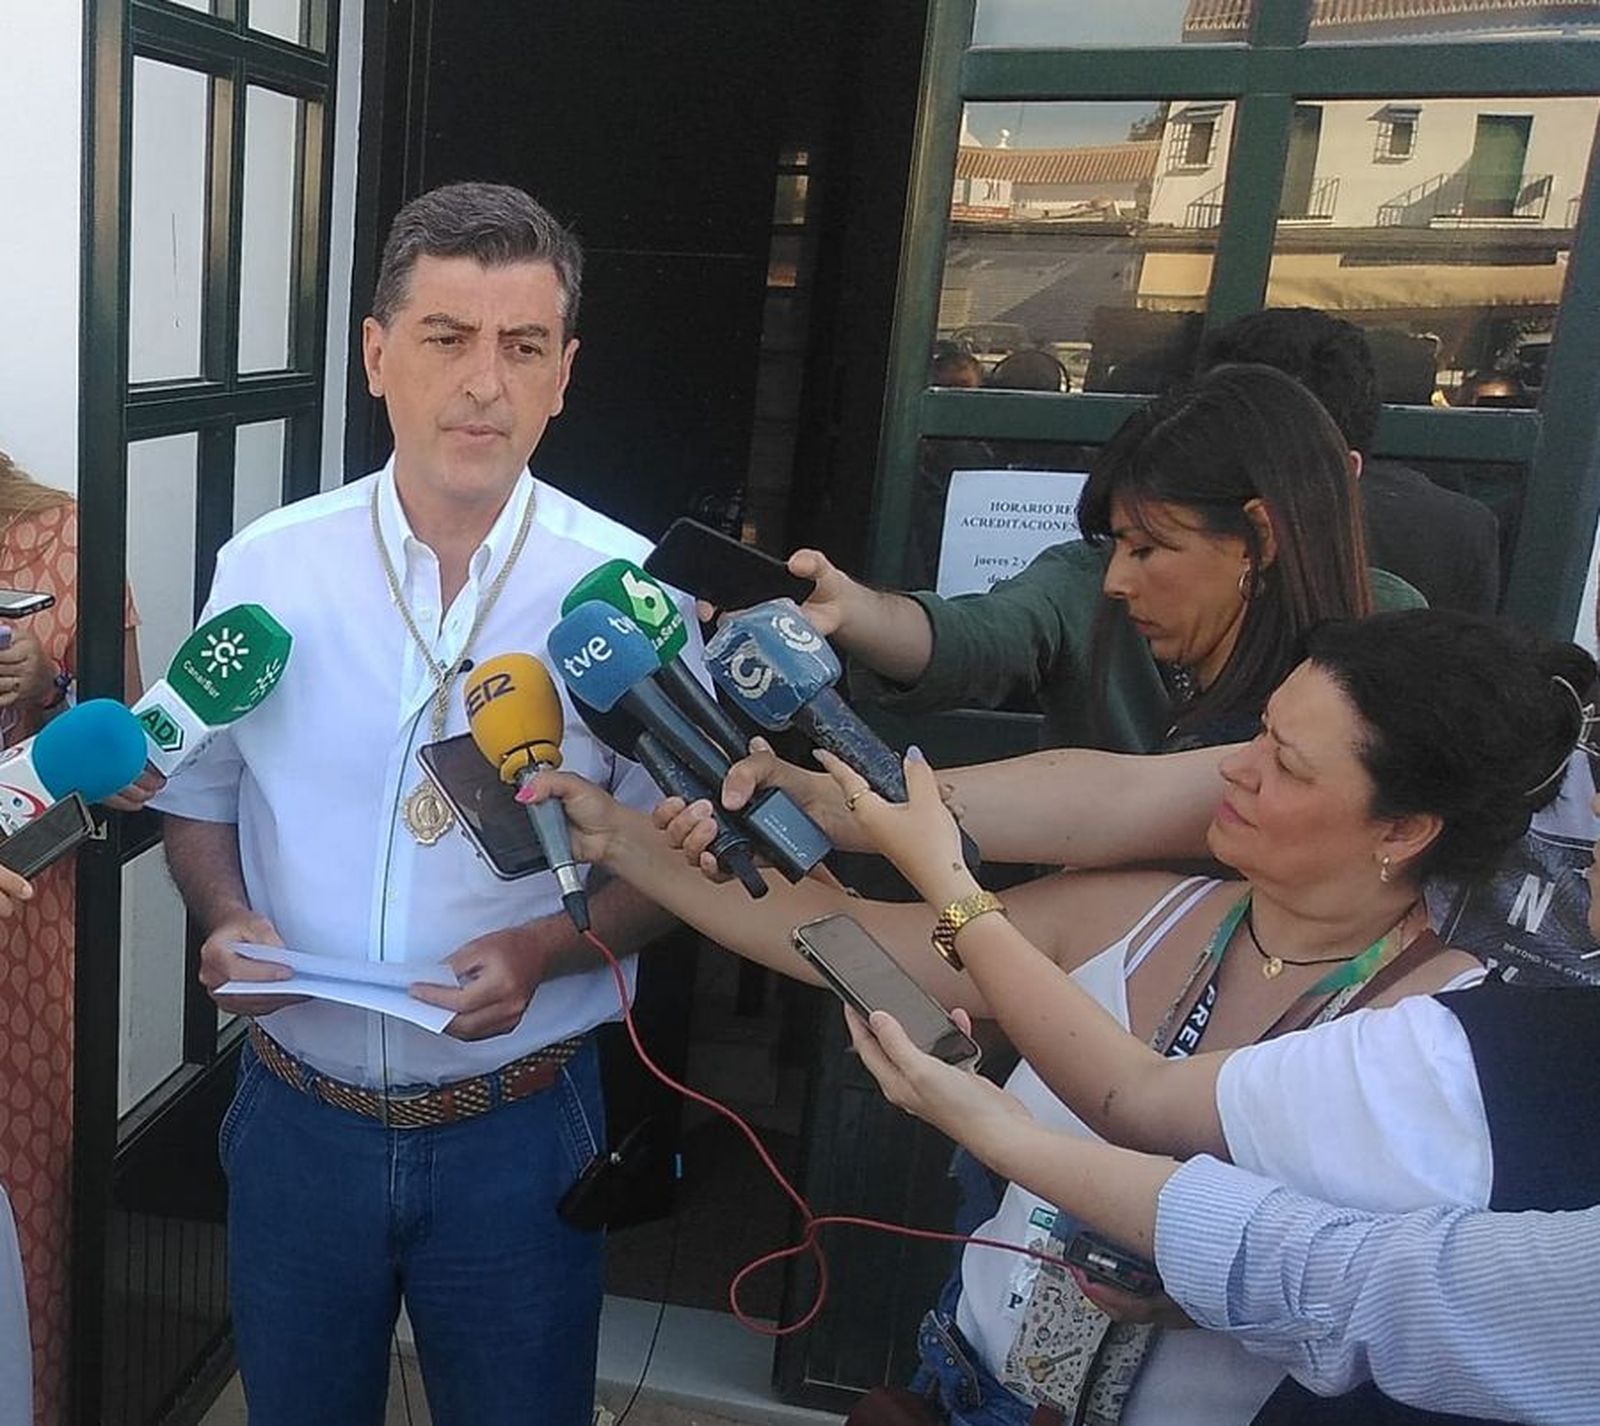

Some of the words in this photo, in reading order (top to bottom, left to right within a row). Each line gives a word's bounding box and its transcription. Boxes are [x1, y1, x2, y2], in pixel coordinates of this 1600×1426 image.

[990, 501, 1053, 515] HORARIO
[1012, 556, 1018, 567] 2
[563, 636, 613, 678] tve
